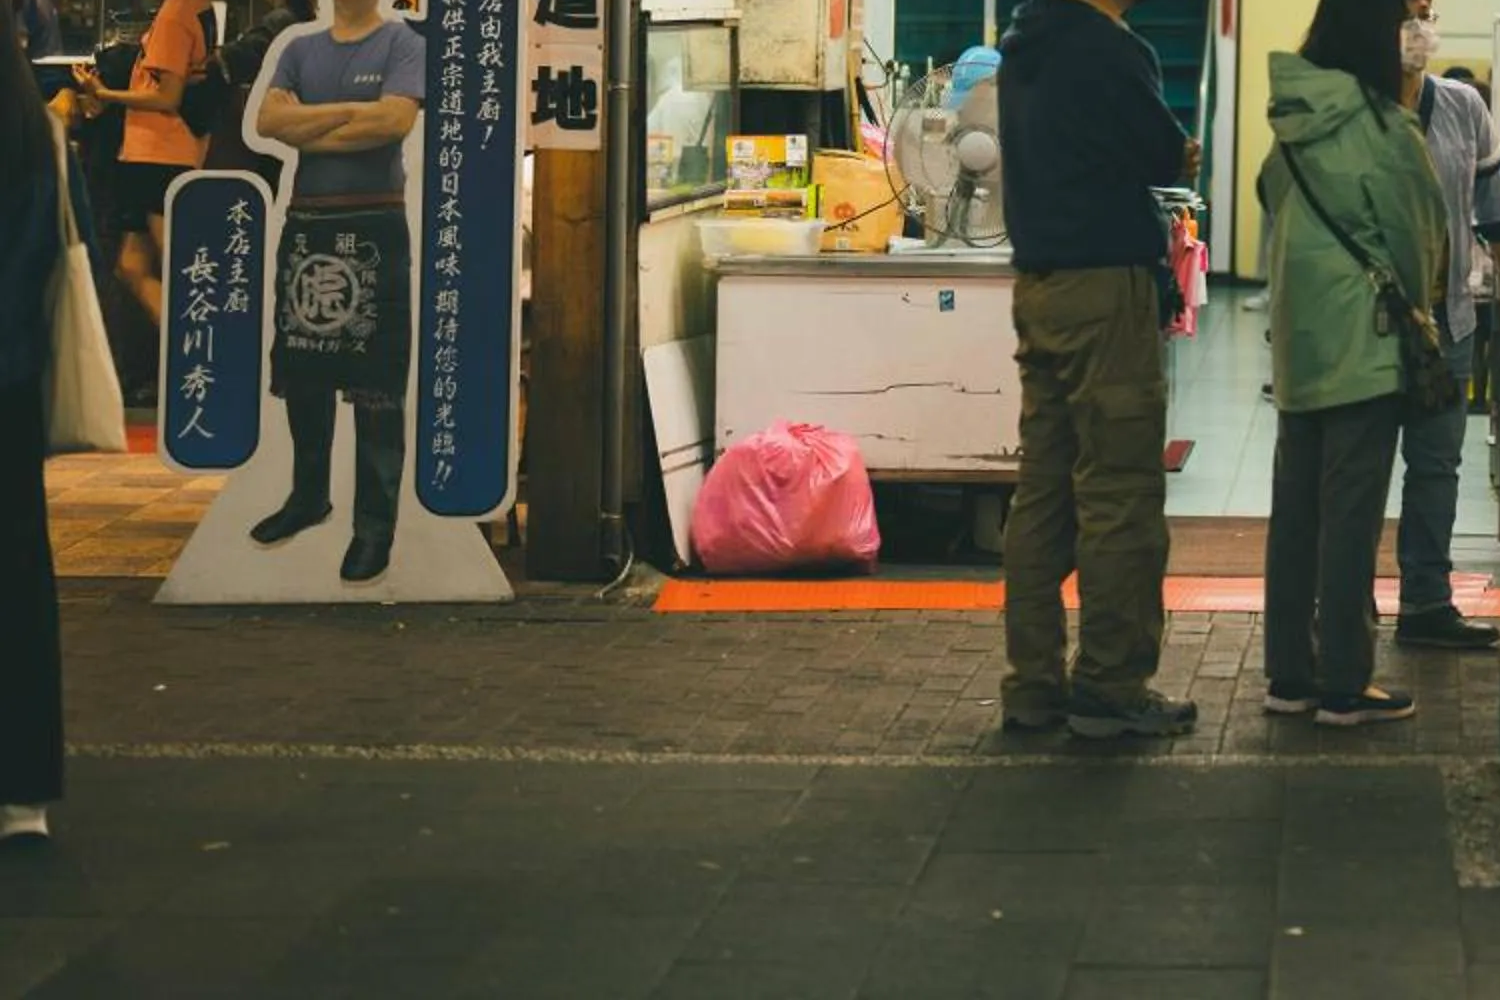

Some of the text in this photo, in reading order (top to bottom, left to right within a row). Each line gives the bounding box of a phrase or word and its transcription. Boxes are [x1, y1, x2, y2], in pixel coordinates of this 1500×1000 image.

[223, 199, 253, 313] 本店主廚
[177, 247, 219, 438] 長谷川秀人
